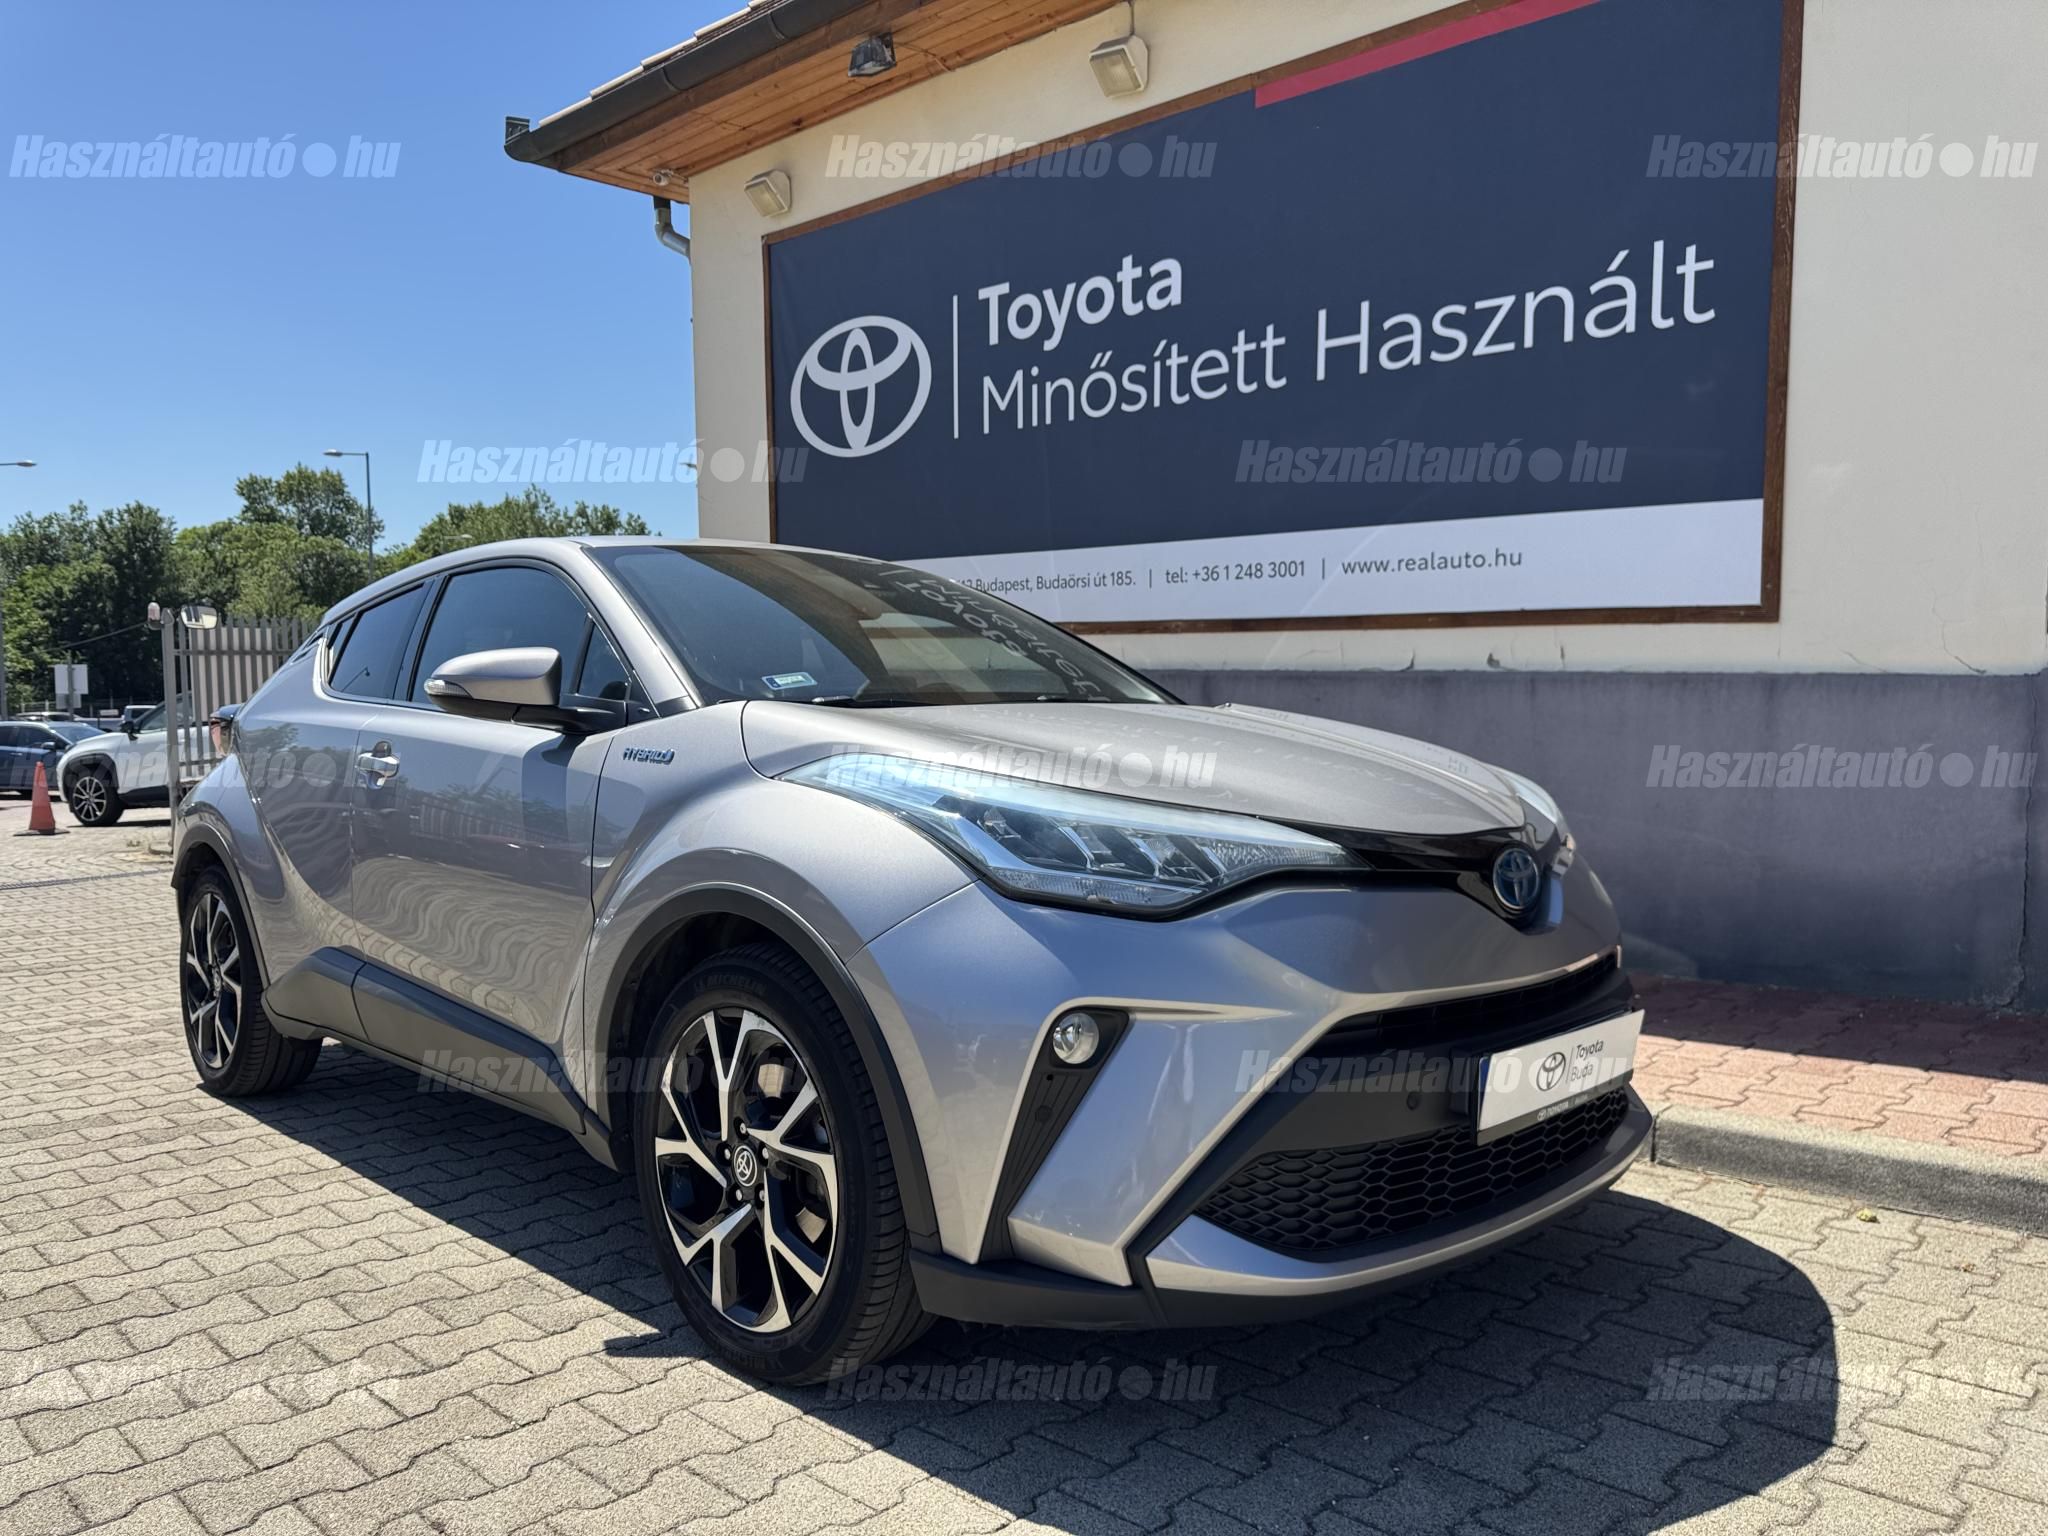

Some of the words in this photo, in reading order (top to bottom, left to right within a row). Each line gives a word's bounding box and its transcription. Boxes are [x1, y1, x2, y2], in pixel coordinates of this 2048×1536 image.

[978, 254, 1182, 350] Toyota
[982, 323, 1287, 434] Minősített
[1316, 240, 1716, 381] Használt
[976, 576, 1033, 595] Budapest,
[1036, 572, 1091, 590] Budaörsi
[1093, 570, 1107, 588] út
[1110, 570, 1136, 587] 185.
[1165, 566, 1189, 584] tel:
[1192, 564, 1220, 582] +36
[1234, 562, 1264, 581] 248
[1268, 560, 1305, 579] 3001
[1341, 547, 1523, 575] www.realauto.hu
[1570, 1062, 1594, 1082] Buda
[1575, 1039, 1604, 1061] Toyota
